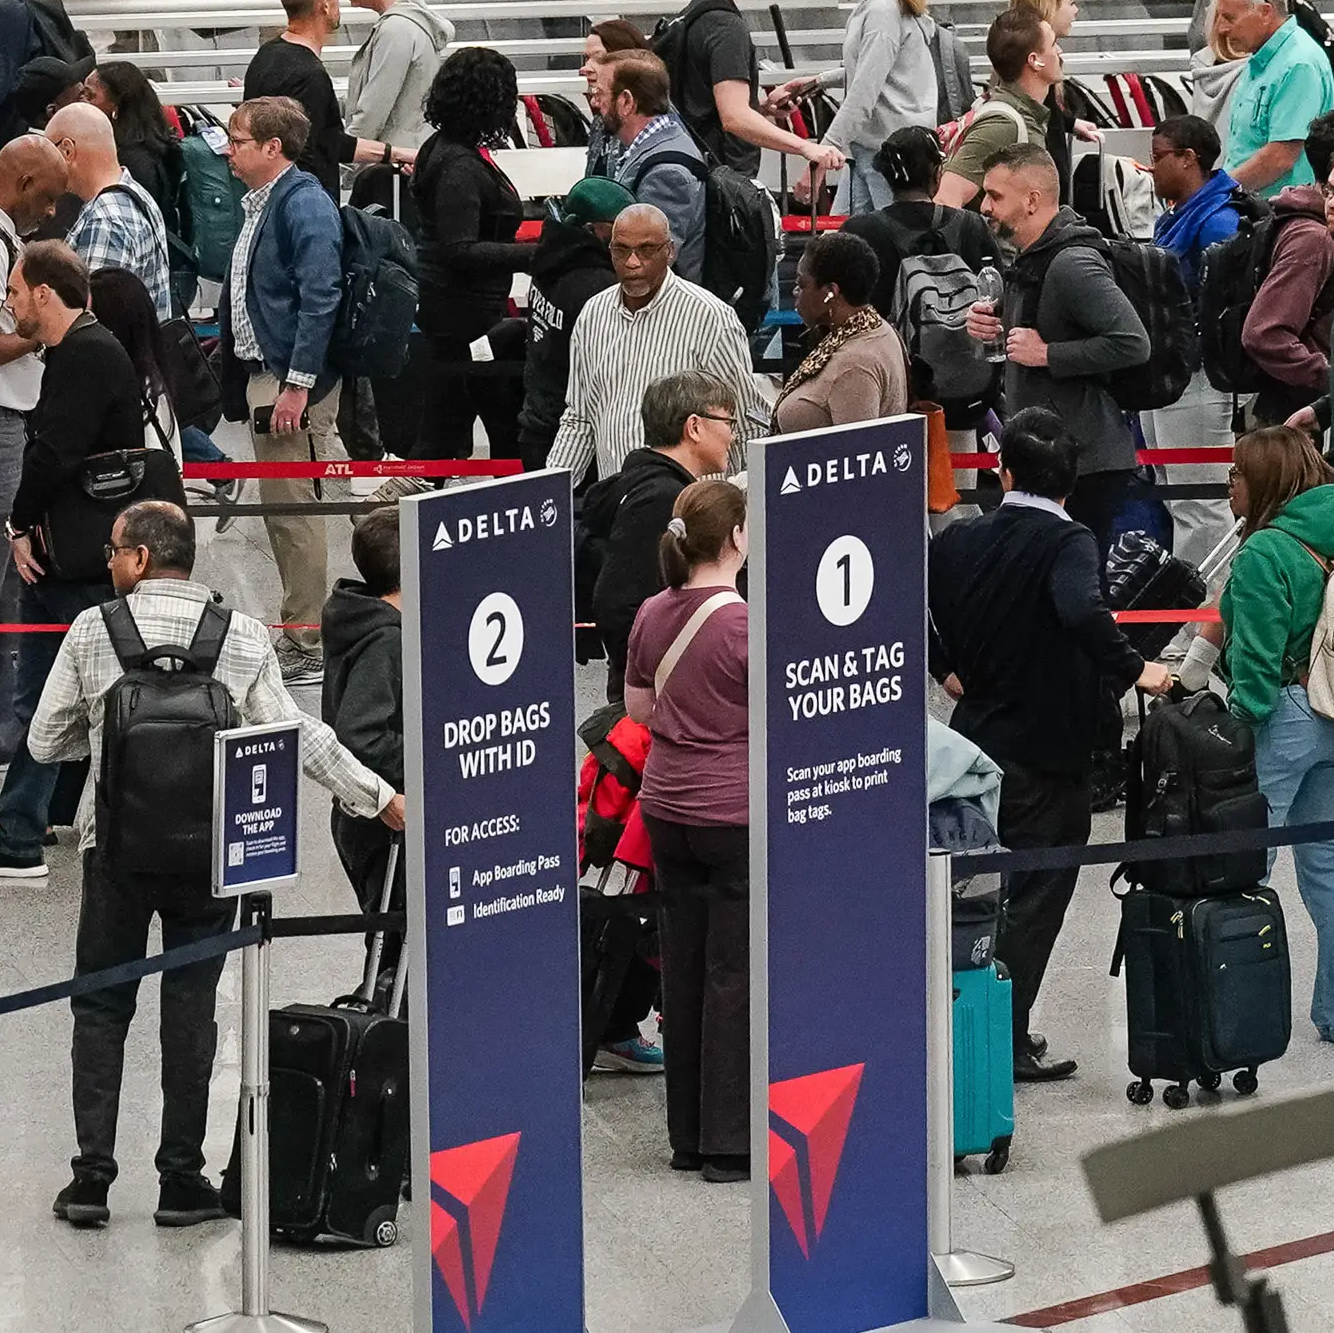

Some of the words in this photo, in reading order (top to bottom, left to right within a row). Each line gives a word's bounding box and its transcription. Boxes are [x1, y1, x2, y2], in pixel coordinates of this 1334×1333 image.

[324, 463, 355, 475] ATL
[806, 451, 888, 488] DELTA
[457, 506, 536, 544] DELTA
[835, 553, 852, 607] 1
[485, 611, 508, 668] 2
[785, 654, 839, 689] SCAN
[843, 651, 859, 677] &
[862, 641, 905, 674] TAG
[788, 686, 846, 721] YOUR
[849, 675, 903, 710] BAGS
[444, 712, 498, 749] DROP
[500, 701, 551, 738] BAGS
[244, 741, 276, 756] DELTA
[459, 743, 512, 779] WITH
[516, 739, 536, 768] ID
[787, 765, 812, 783] Scan
[813, 762, 835, 780] your
[837, 758, 856, 775] app
[858, 747, 902, 769] boarding
[787, 786, 811, 806] pass
[812, 784, 823, 797] at
[824, 775, 851, 796] kiosk
[852, 776, 863, 790] to
[864, 769, 889, 790] print
[235, 807, 282, 825] DOWNLOAD
[243, 823, 259, 836] THE
[259, 821, 275, 834] APP
[445, 827, 469, 847] FOR
[471, 814, 520, 841] ACCESS:
[787, 808, 807, 824] bag
[808, 803, 832, 820] tags.
[472, 869, 493, 888] App
[494, 859, 537, 882] Boarding
[537, 855, 561, 872] Pass
[473, 890, 535, 919] Identification
[536, 884, 566, 905] Ready
